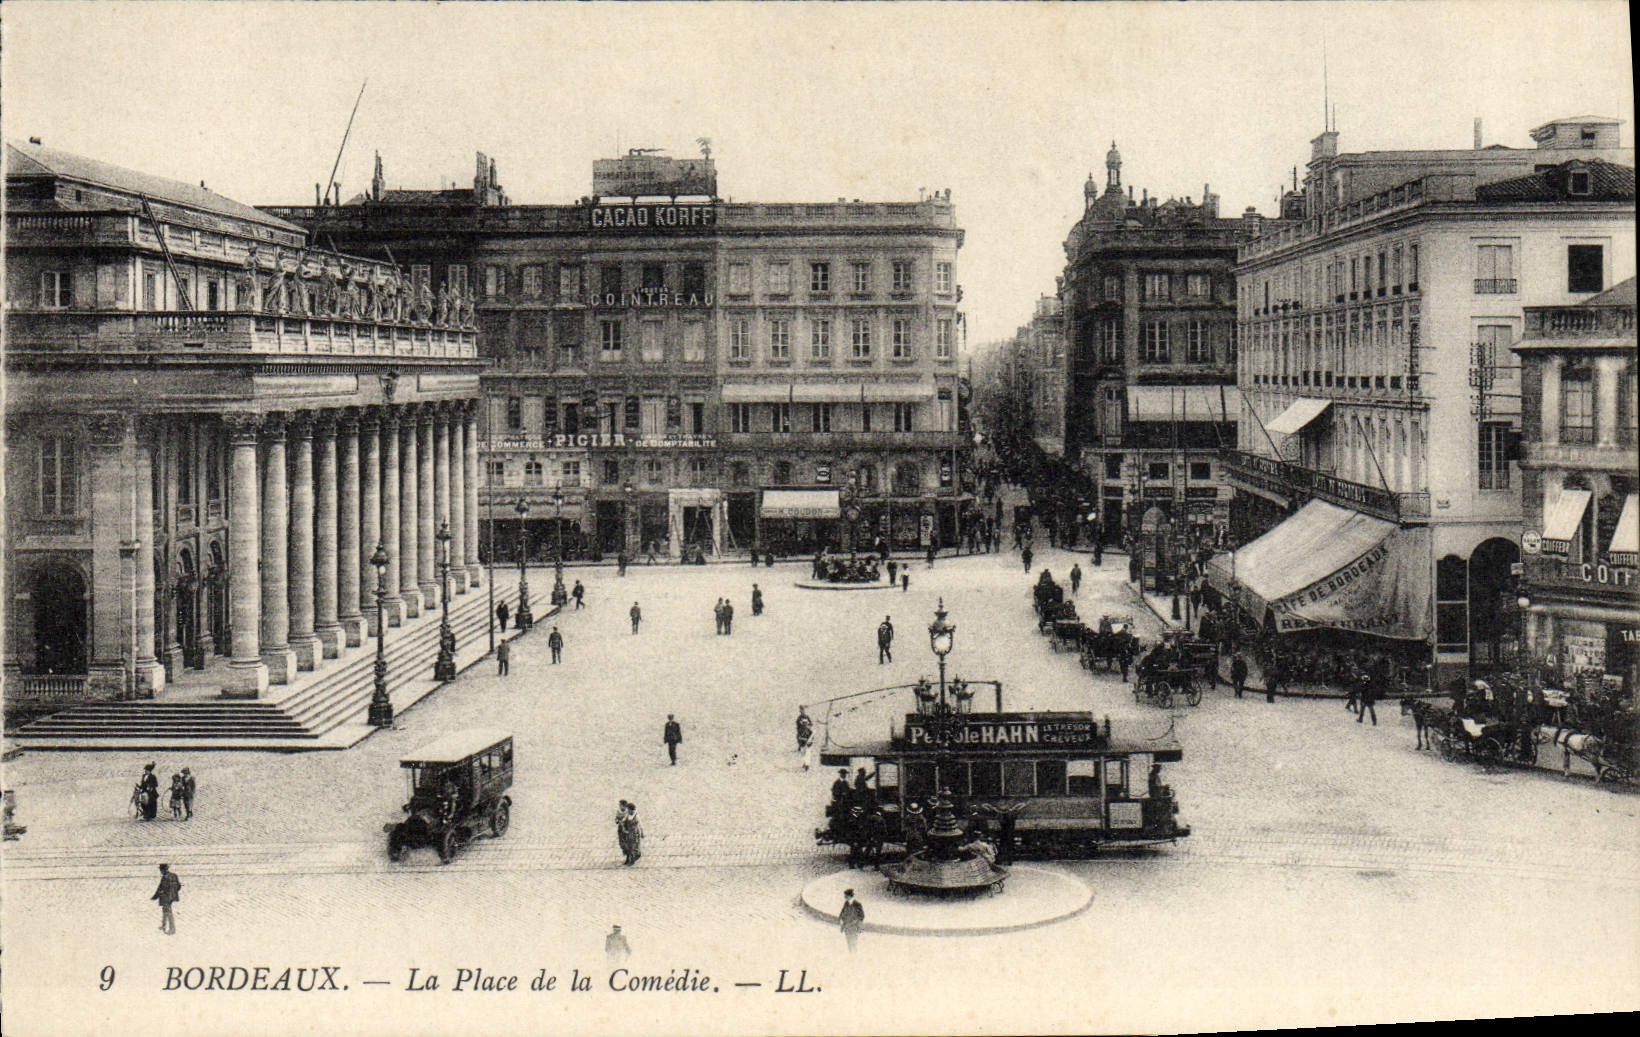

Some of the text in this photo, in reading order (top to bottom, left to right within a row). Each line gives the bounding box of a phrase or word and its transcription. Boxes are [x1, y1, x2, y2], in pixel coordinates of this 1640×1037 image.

[592, 207, 713, 227] CACAO KORFF
[591, 293, 714, 306] COINTREAU
[555, 434, 626, 447] PIGIER
[1308, 586, 1326, 602] DE
[1328, 544, 1388, 593] BORDEAUX
[981, 726, 1040, 744] HAHN
